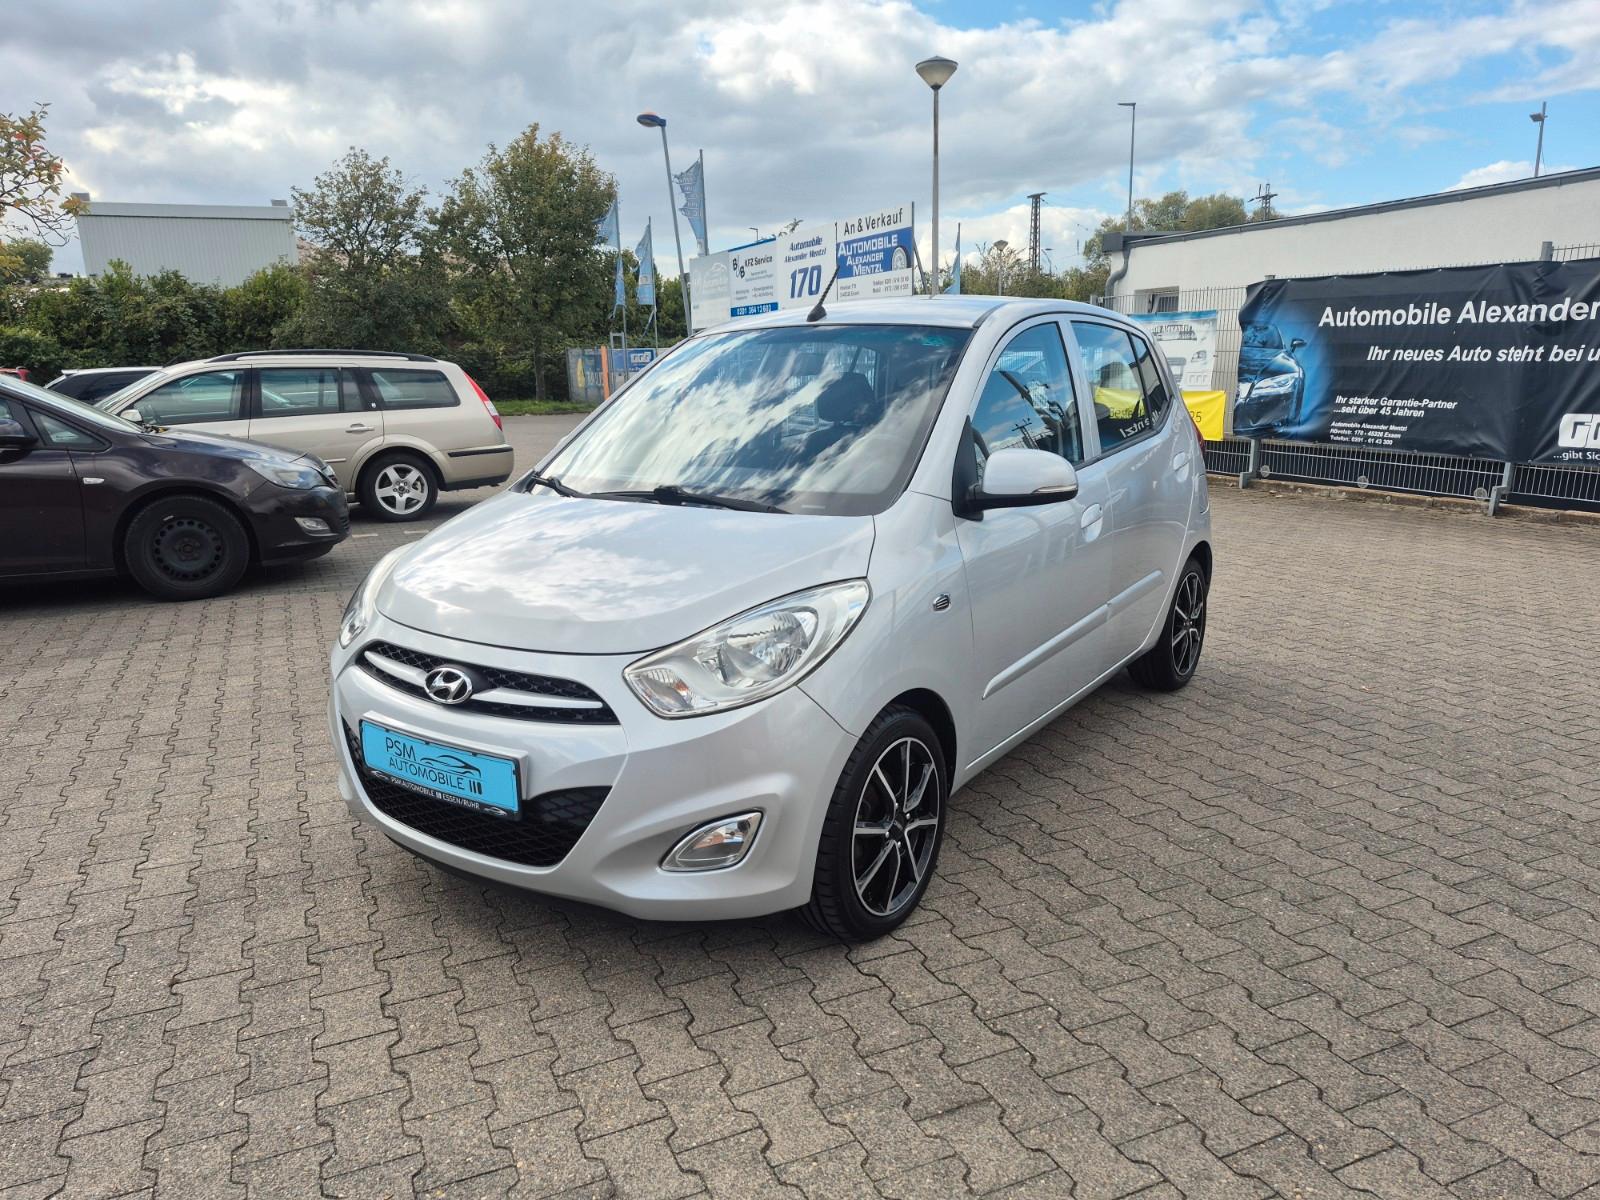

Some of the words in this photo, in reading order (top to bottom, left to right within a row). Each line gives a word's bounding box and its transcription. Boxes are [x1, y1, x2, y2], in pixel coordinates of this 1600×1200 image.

[843, 221, 855, 236] An
[857, 219, 863, 233] &
[865, 208, 903, 230] Verkauf
[790, 235, 823, 251] Automobile
[837, 234, 898, 256] AUTOMOBILE
[754, 255, 773, 266] Service
[784, 253, 808, 263] Alexander
[846, 252, 884, 266] ALEXANDER
[853, 263, 884, 277] MENTZL
[790, 264, 822, 299] 170
[1318, 302, 1451, 327] Automobile
[1456, 297, 1600, 323] Alexander
[1367, 345, 1390, 361] Ihr
[1392, 348, 1444, 361] neues
[1447, 345, 1492, 362] Auto
[1496, 345, 1544, 362] steht
[1548, 344, 1586, 362] bei
[1335, 395, 1348, 404] Ihr
[1348, 396, 1378, 406] starker
[1380, 397, 1458, 409] Garantie-Partner
[1333, 405, 1356, 414] ...seit
[1358, 406, 1378, 415] über
[1379, 406, 1391, 416] 45
[1393, 407, 1425, 418] Jahren
[1361, 422, 1389, 430] Alexander
[1553, 450, 1583, 461] ...gibt
[385, 737, 417, 761] PSM
[389, 757, 465, 790] AUTOMOBILE
[401, 781, 435, 797] AUTOMOBILE
